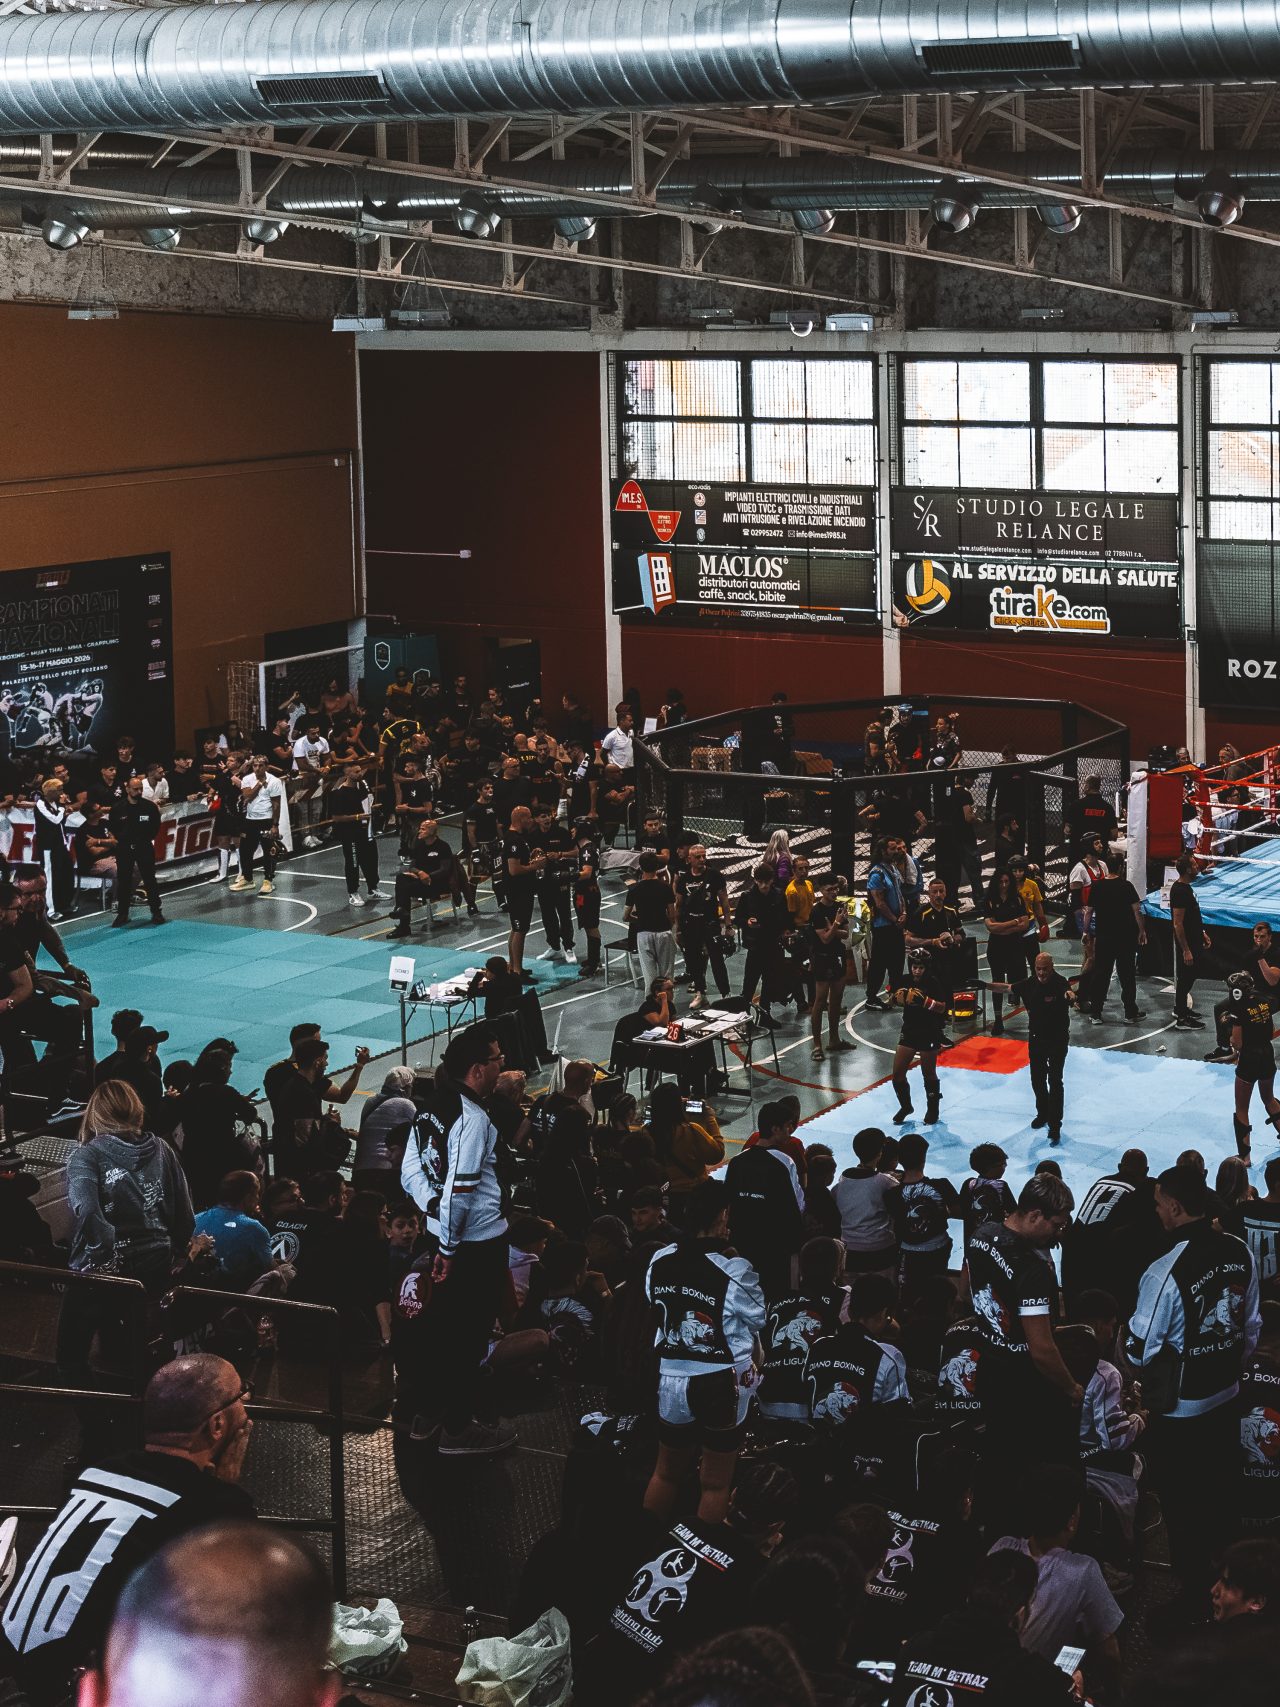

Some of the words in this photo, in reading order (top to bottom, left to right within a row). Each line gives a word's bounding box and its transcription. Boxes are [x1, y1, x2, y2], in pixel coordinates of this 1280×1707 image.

[724, 491, 754, 502] IMPIANTI
[756, 492, 791, 504] ELETTRICI
[792, 494, 812, 504] CIVILI
[814, 496, 818, 504] e
[820, 494, 862, 506] INDUSTRIALI
[736, 502, 757, 513] VIDEO
[758, 503, 777, 514] TVCC
[778, 505, 782, 514] e
[784, 504, 833, 516] TRASMISSIONE
[835, 506, 851, 516] DATI
[956, 498, 1043, 517] STUDIO
[1055, 502, 1145, 520] LEGALE
[722, 513, 739, 523] ANTI
[740, 514, 780, 525] INTRUSIONE
[782, 516, 786, 524] e
[788, 515, 832, 526] RIVELAZIONE
[834, 516, 866, 527] INCENDIO
[996, 522, 1103, 541] RELANCE
[698, 554, 783, 578] MACLOS
[952, 562, 973, 579] AL
[978, 564, 1057, 583] SERVIZIO
[1062, 568, 1112, 586] DELLA
[1117, 569, 1178, 588] SALUTE
[698, 577, 748, 589] distributori
[750, 580, 800, 591] automatici
[698, 588, 726, 600] caffè,
[727, 590, 758, 602] snack,
[759, 591, 786, 602] bibite
[46, 656, 74, 668] MAGGIO
[682, 1286, 716, 1306] BOXING
[833, 1360, 865, 1376] BOXING
[673, 1524, 694, 1541] TEAM
[640, 1626, 664, 1646] Club
[907, 1660, 930, 1676] TEAM
